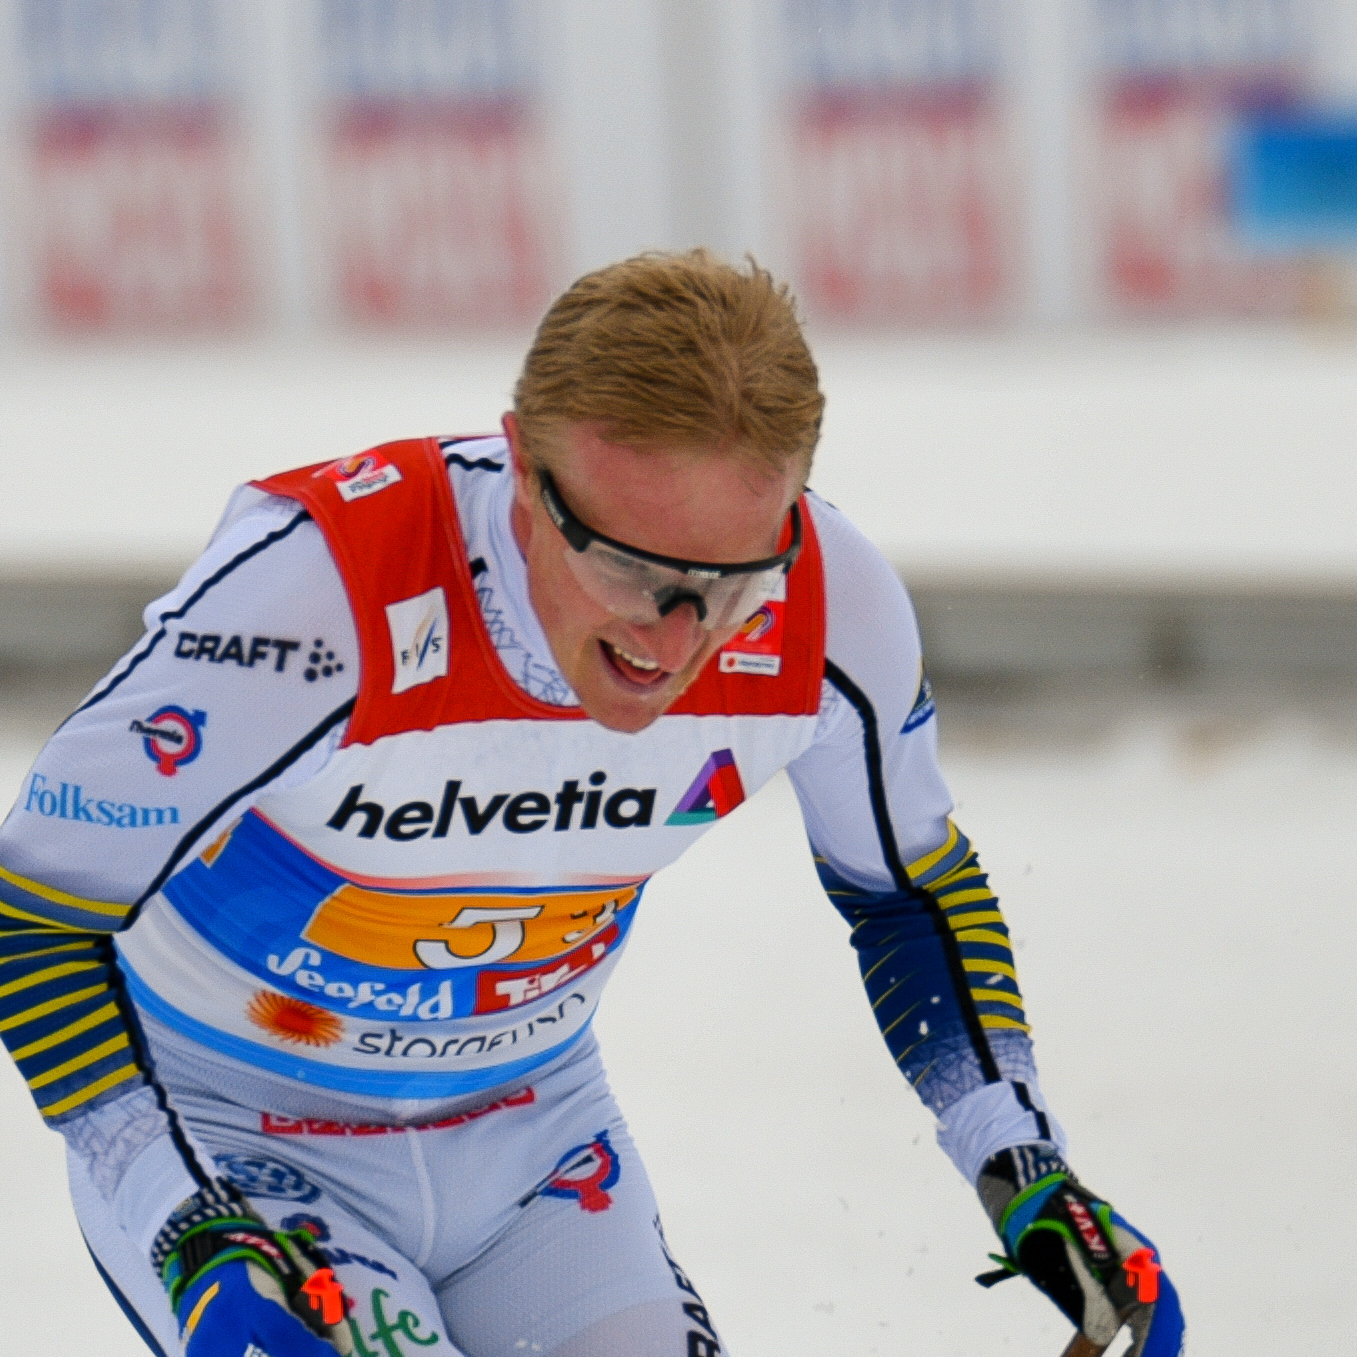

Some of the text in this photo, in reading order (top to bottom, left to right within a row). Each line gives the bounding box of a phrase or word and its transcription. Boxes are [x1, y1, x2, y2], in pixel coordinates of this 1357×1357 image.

[175, 631, 300, 673] CRAFT
[24, 772, 180, 829] Folksam
[326, 770, 657, 842] helvetia
[412, 904, 545, 970] 5
